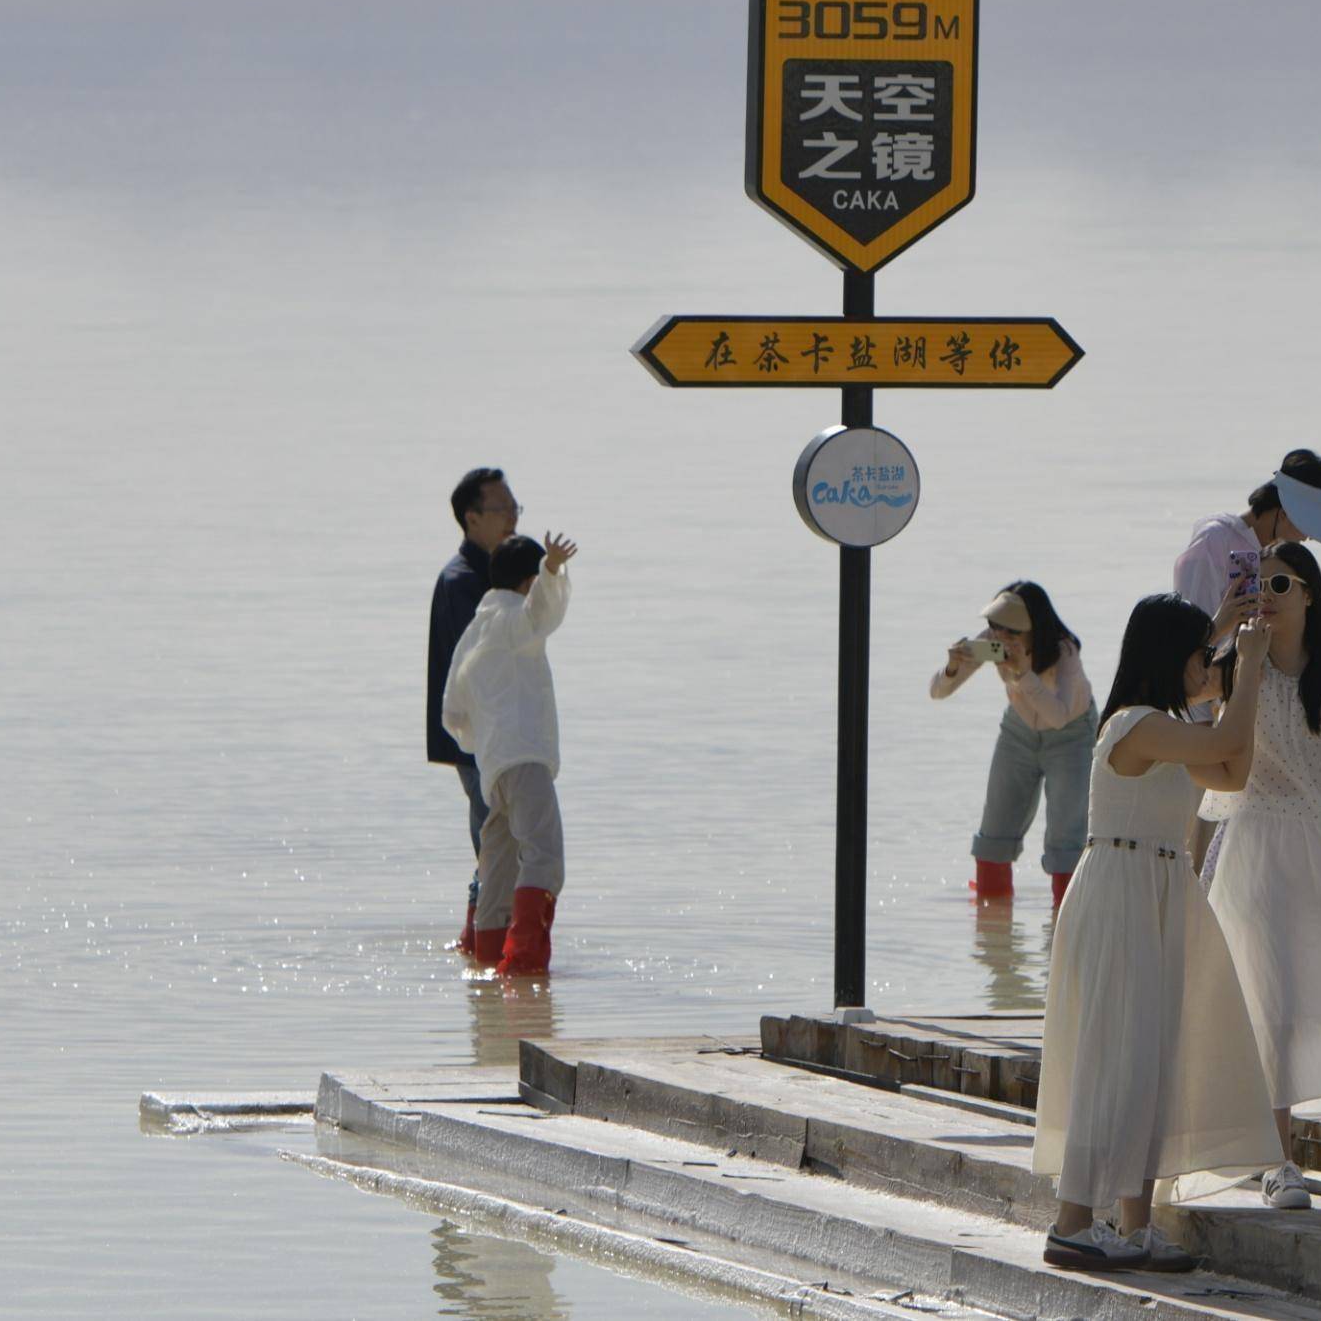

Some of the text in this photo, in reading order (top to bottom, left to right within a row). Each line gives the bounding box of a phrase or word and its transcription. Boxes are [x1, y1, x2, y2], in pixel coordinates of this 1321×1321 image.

[778, 0, 959, 40] 3059 M
[799, 74, 936, 122] 天空
[798, 132, 936, 181] 之镜
[832, 189, 899, 210] CAKA
[704, 331, 1022, 375] 在茶卡盐湖等你
